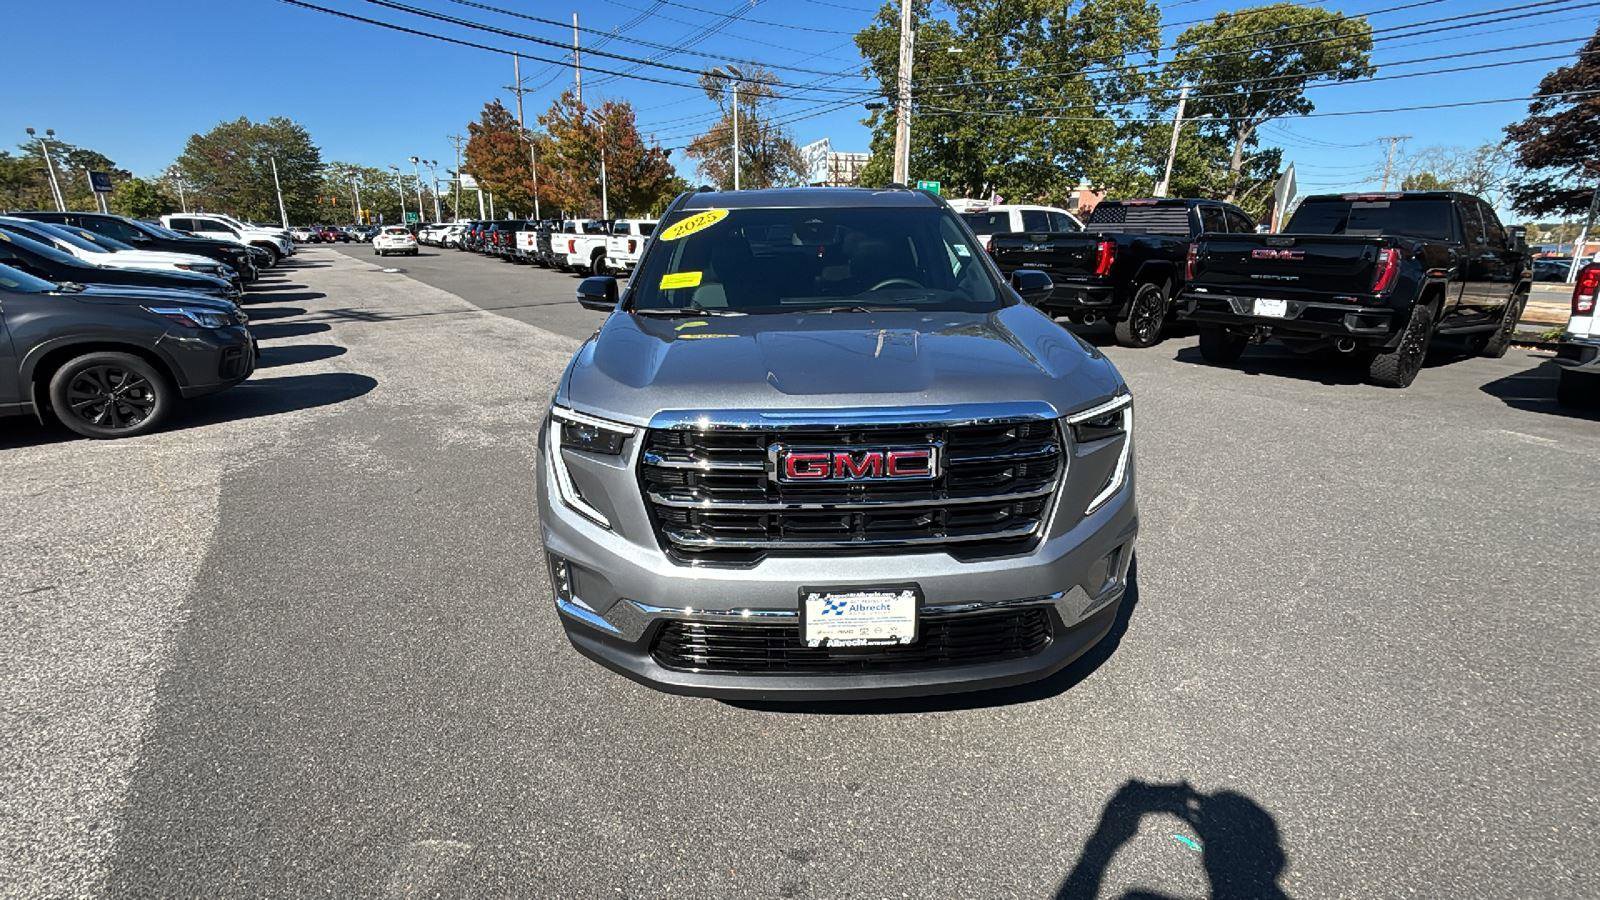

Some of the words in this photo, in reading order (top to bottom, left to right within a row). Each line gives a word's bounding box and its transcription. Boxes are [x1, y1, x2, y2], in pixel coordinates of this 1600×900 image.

[674, 213, 717, 237] 2025
[1251, 248, 1306, 261] GMC
[786, 451, 930, 479] GMC
[849, 604, 891, 612] Albrecht
[827, 639, 868, 648] Albrecht
